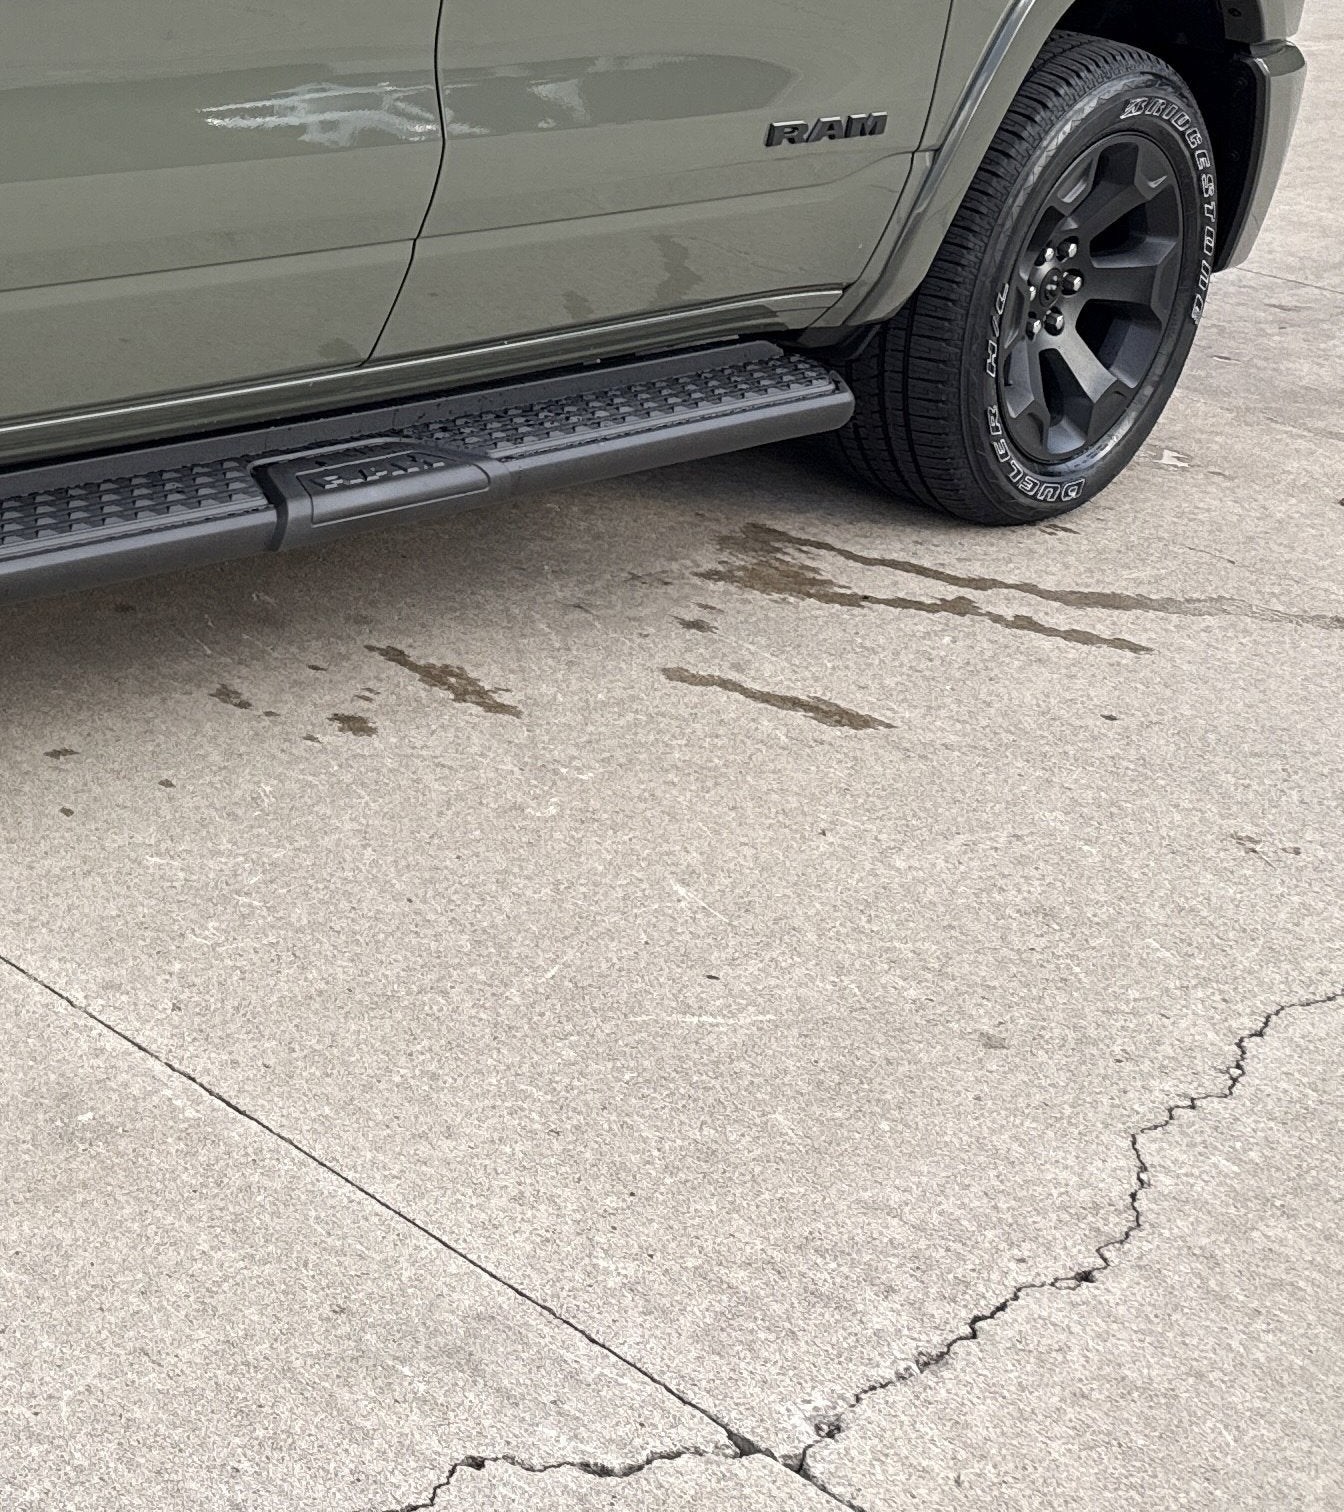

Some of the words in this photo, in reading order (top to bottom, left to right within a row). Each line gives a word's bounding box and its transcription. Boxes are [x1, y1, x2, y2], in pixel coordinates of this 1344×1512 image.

[765, 111, 888, 147] RAM
[1120, 97, 1216, 324] BRIDGESTONE
[986, 283, 1009, 377] H/L
[987, 405, 1086, 502] DUELER
